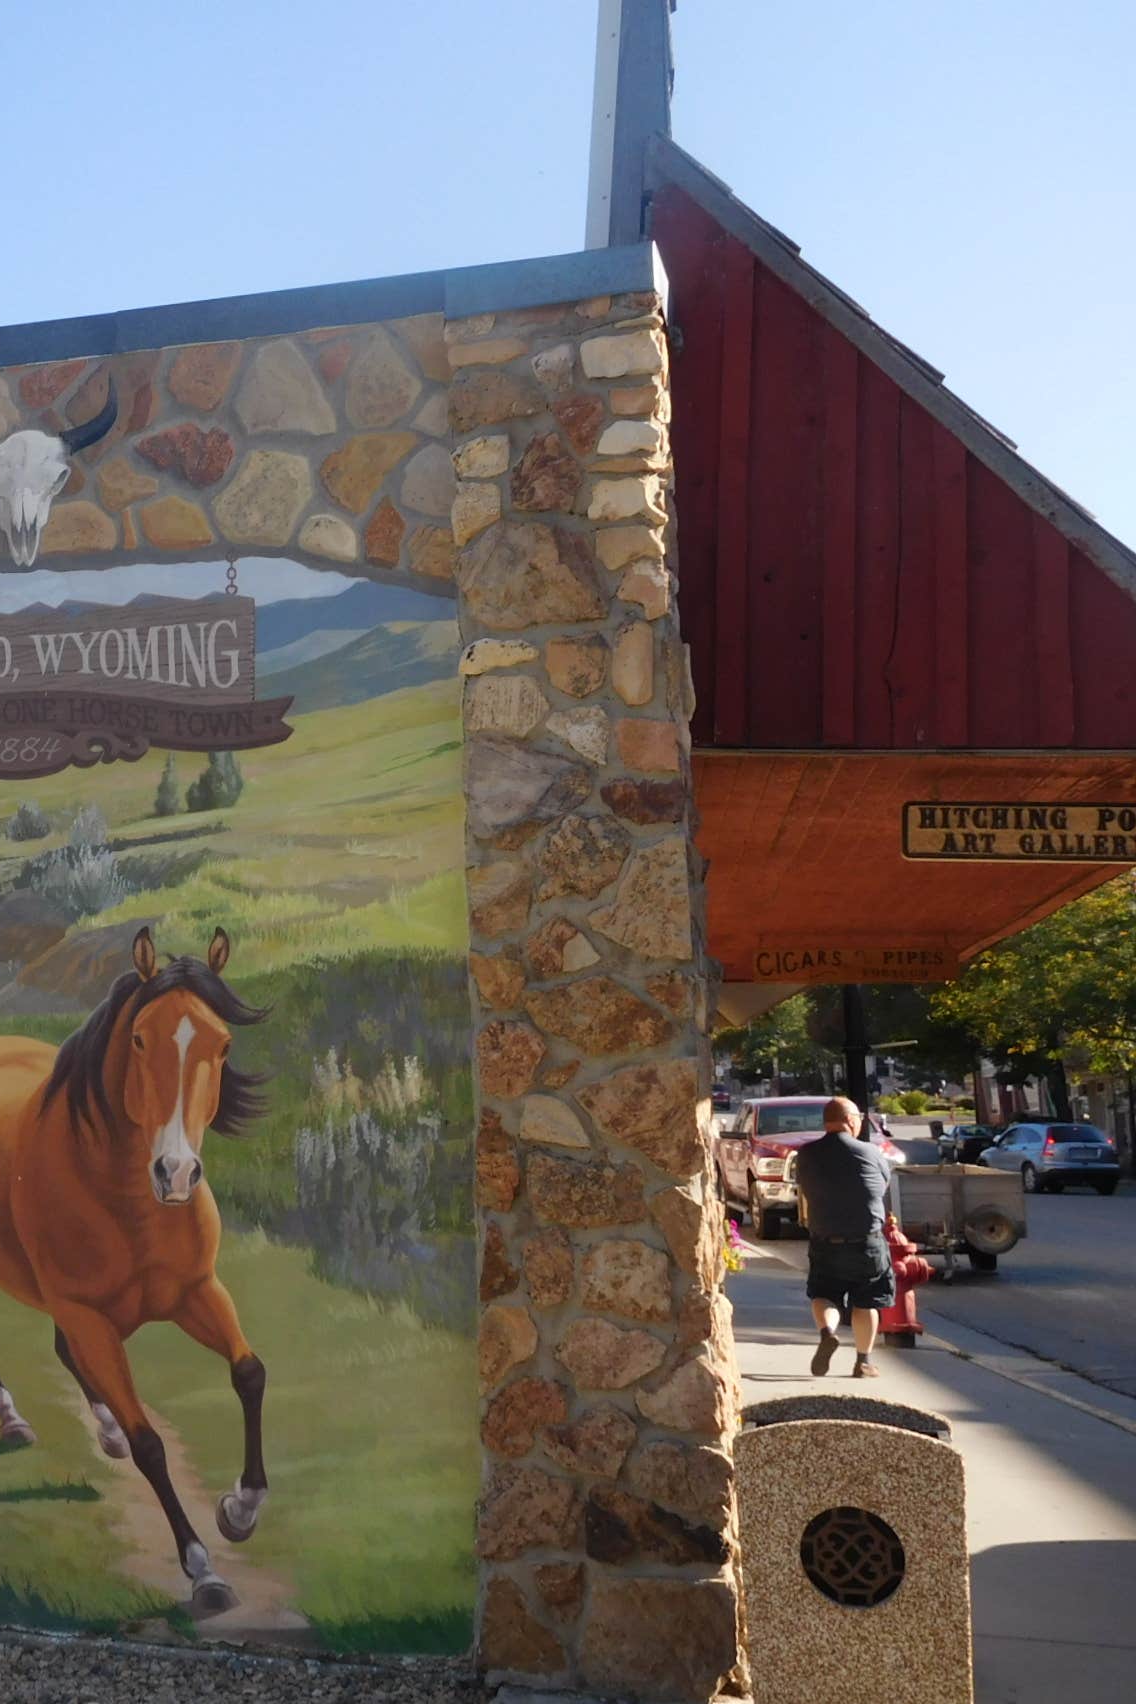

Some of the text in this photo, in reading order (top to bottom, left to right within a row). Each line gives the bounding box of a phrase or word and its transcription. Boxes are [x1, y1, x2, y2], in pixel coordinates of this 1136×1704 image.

[31, 619, 240, 688] WYOMING
[1, 698, 58, 725] ONE
[69, 700, 159, 732] HORSE
[172, 708, 256, 738] TOWN
[919, 807, 1067, 830] HITCHING
[942, 833, 996, 853] ART
[883, 951, 944, 966] PIPES
